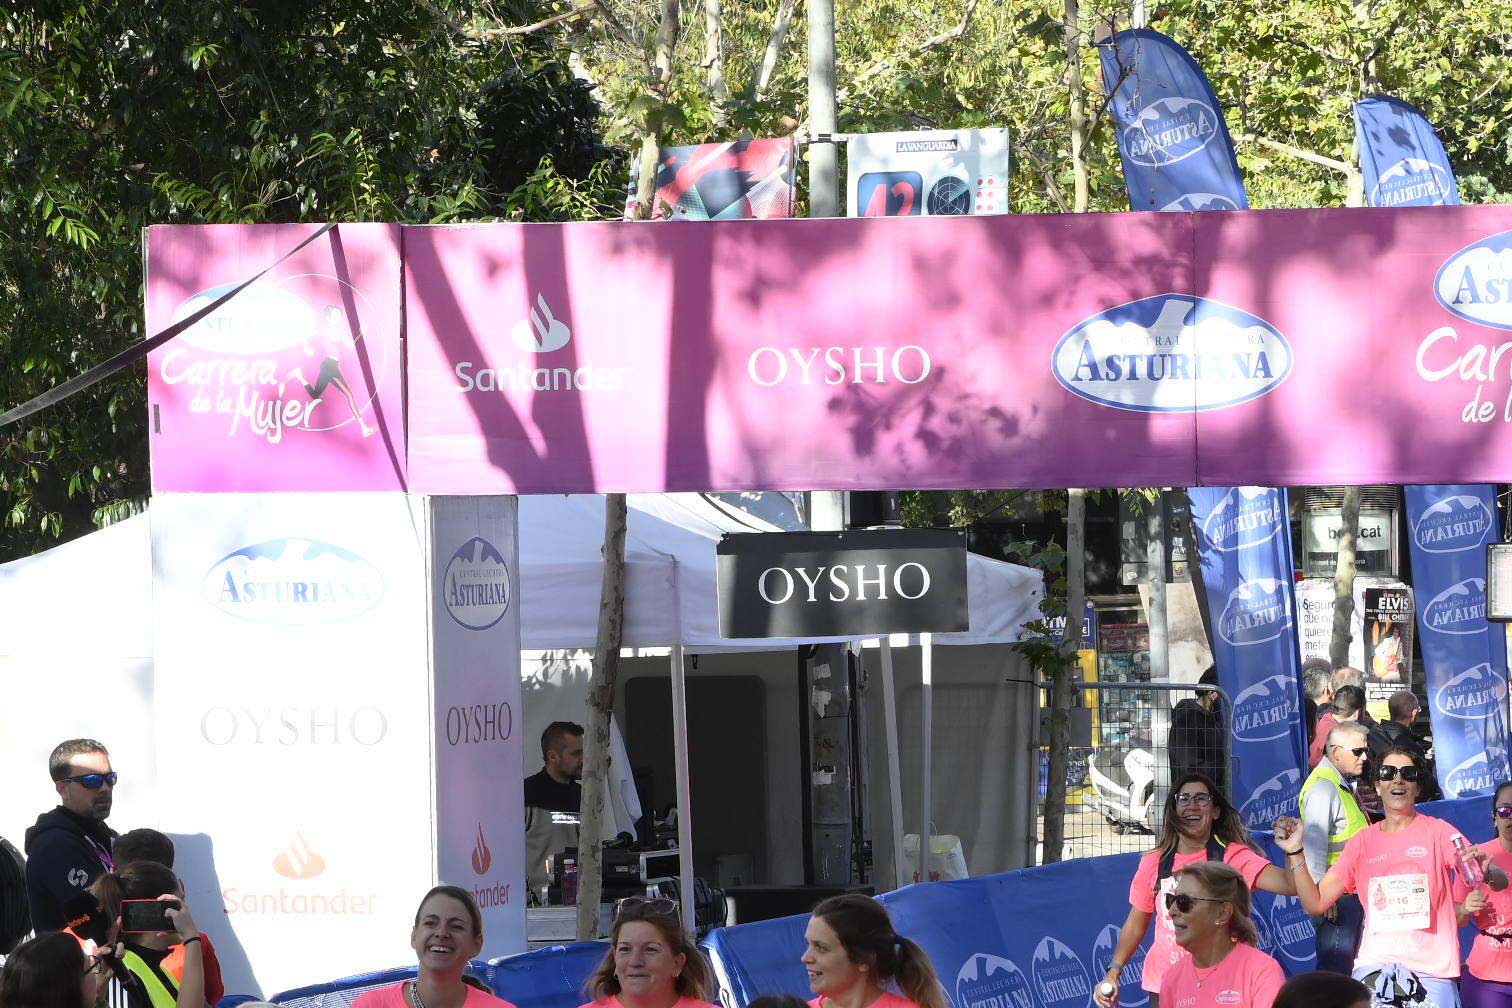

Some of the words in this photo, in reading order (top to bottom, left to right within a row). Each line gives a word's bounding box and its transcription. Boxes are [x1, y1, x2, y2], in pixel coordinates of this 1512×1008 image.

[454, 357, 627, 393] Santander
[747, 344, 932, 388] OYSHO
[1071, 338, 1274, 383] ASTURIANA
[1460, 392, 1496, 424] de
[448, 577, 507, 607] ASTURIANA
[758, 562, 932, 604] OYSHO
[1378, 597, 1409, 610] ELVIS
[200, 705, 389, 747] OYSHO
[446, 701, 513, 748] OYSHO
[222, 886, 378, 917] Santander
[473, 881, 511, 909] tander
[1279, 920, 1315, 946] ASTURIAN
[1038, 971, 1090, 1004] ASTURIANA
